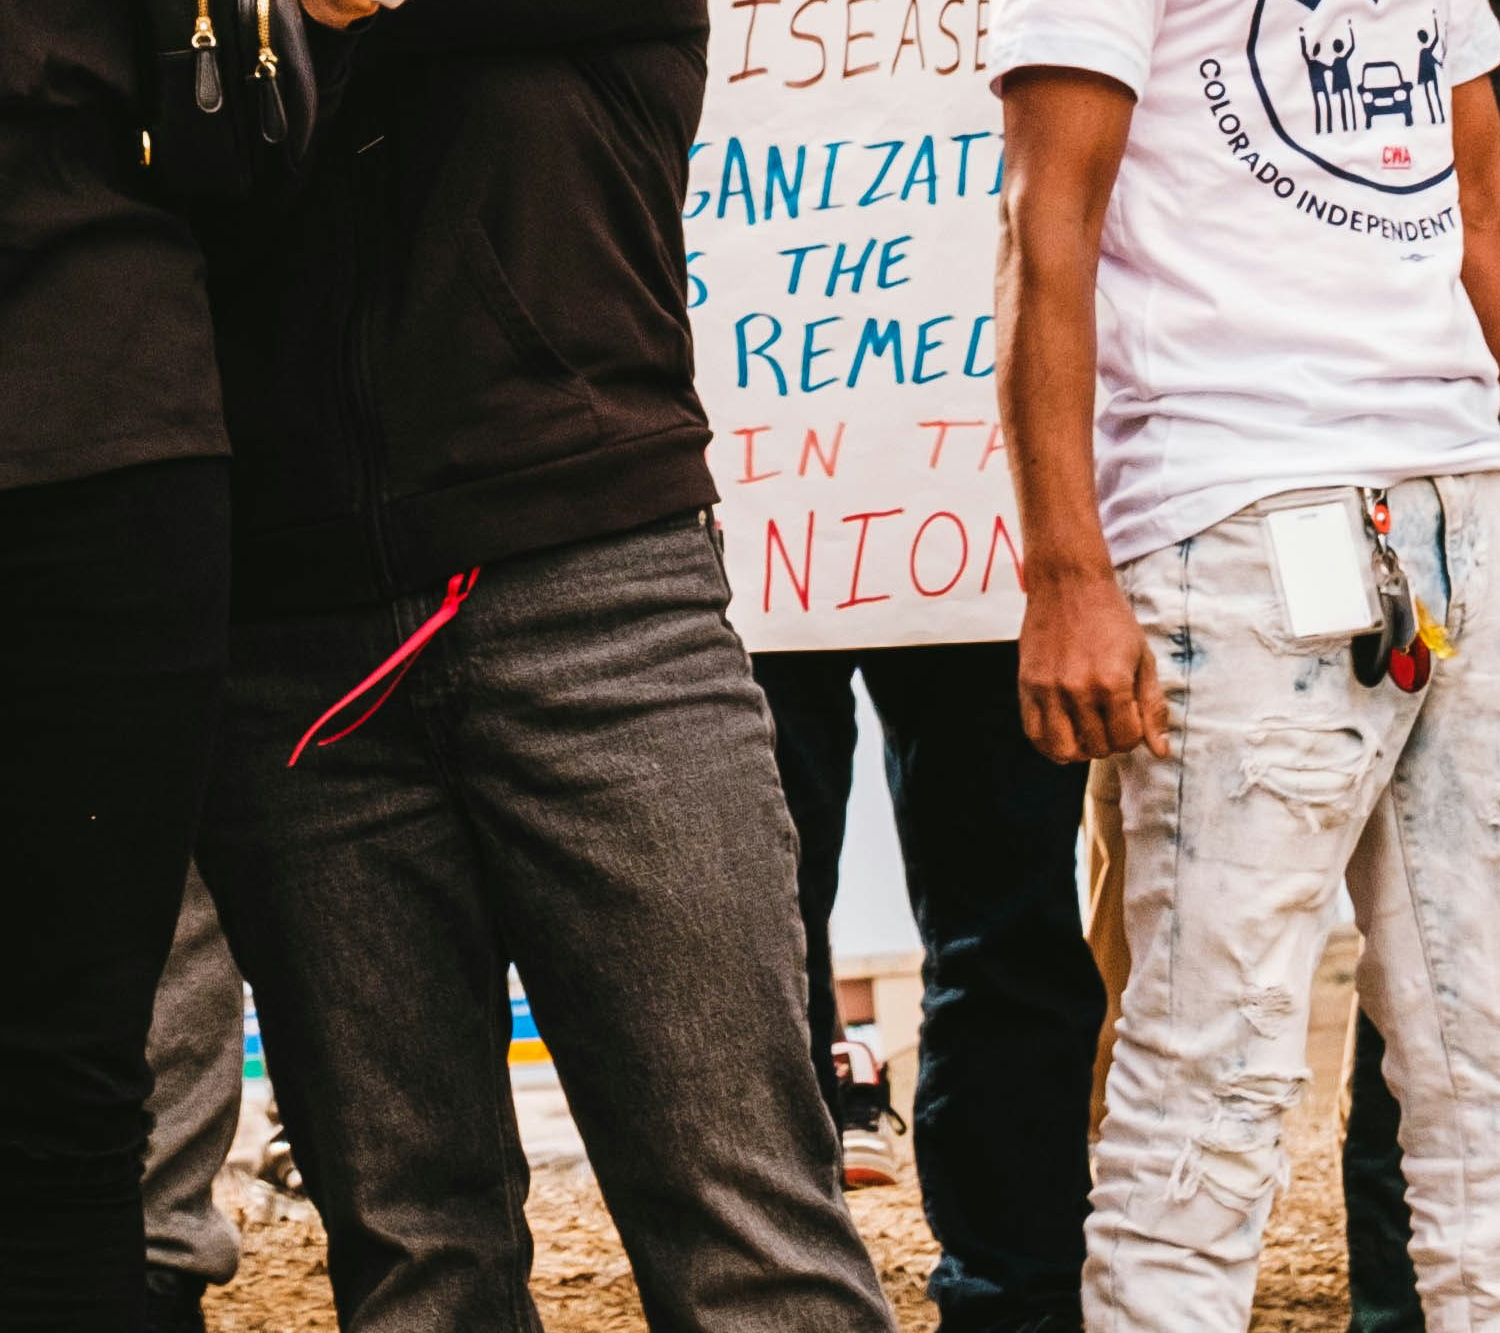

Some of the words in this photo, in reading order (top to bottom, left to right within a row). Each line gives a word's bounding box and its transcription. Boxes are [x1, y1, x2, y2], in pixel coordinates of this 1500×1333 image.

[1199, 57, 1296, 199] COLORADO
[1296, 190, 1457, 243] INDEPENDENT
[777, 234, 914, 298] THE
[731, 421, 846, 484] IN
